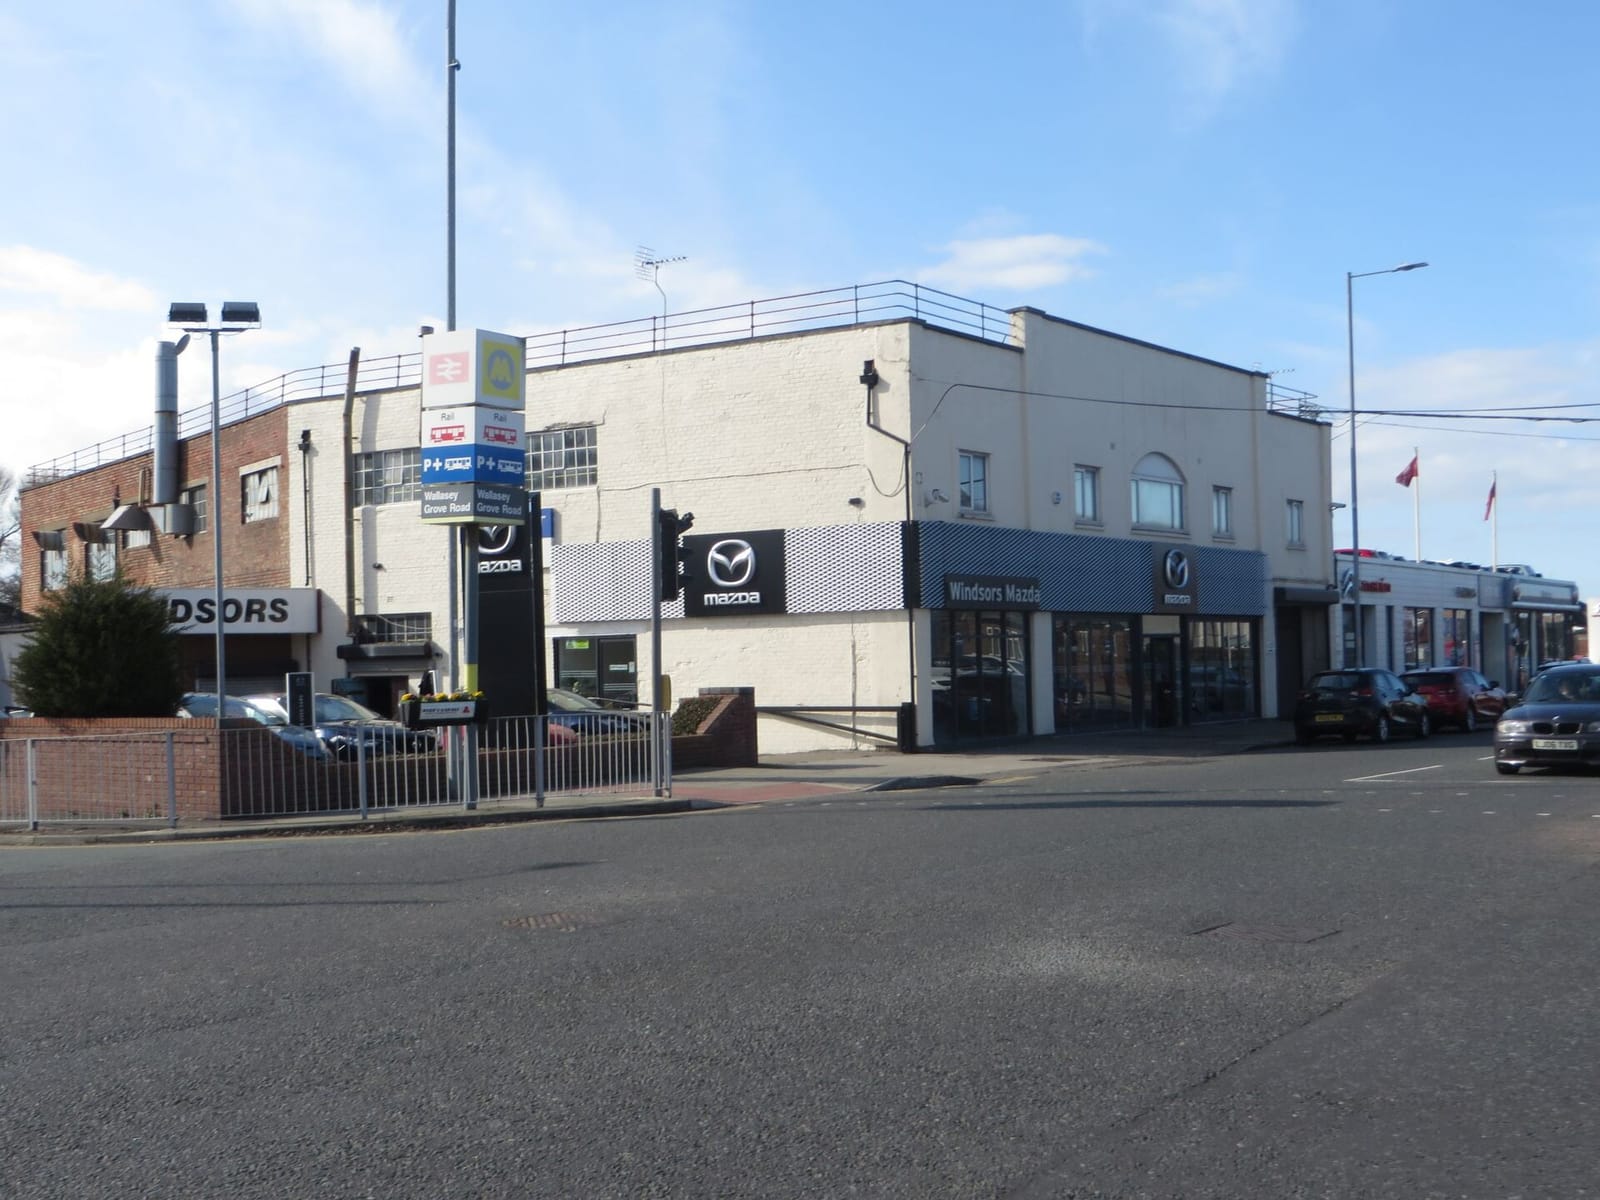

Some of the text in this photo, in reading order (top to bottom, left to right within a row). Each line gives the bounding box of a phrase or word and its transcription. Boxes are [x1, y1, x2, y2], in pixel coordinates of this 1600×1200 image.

[441, 412, 455, 421] Rail
[494, 413, 508, 422] Rail
[424, 491, 459, 502] Wallasey
[476, 489, 511, 503] Wallasey
[424, 502, 471, 514] Grove Road
[476, 503, 522, 515] Grove Road
[704, 591, 761, 606] mazda
[949, 582, 1040, 603] Windsors Mazda
[168, 598, 289, 623] DSORS
